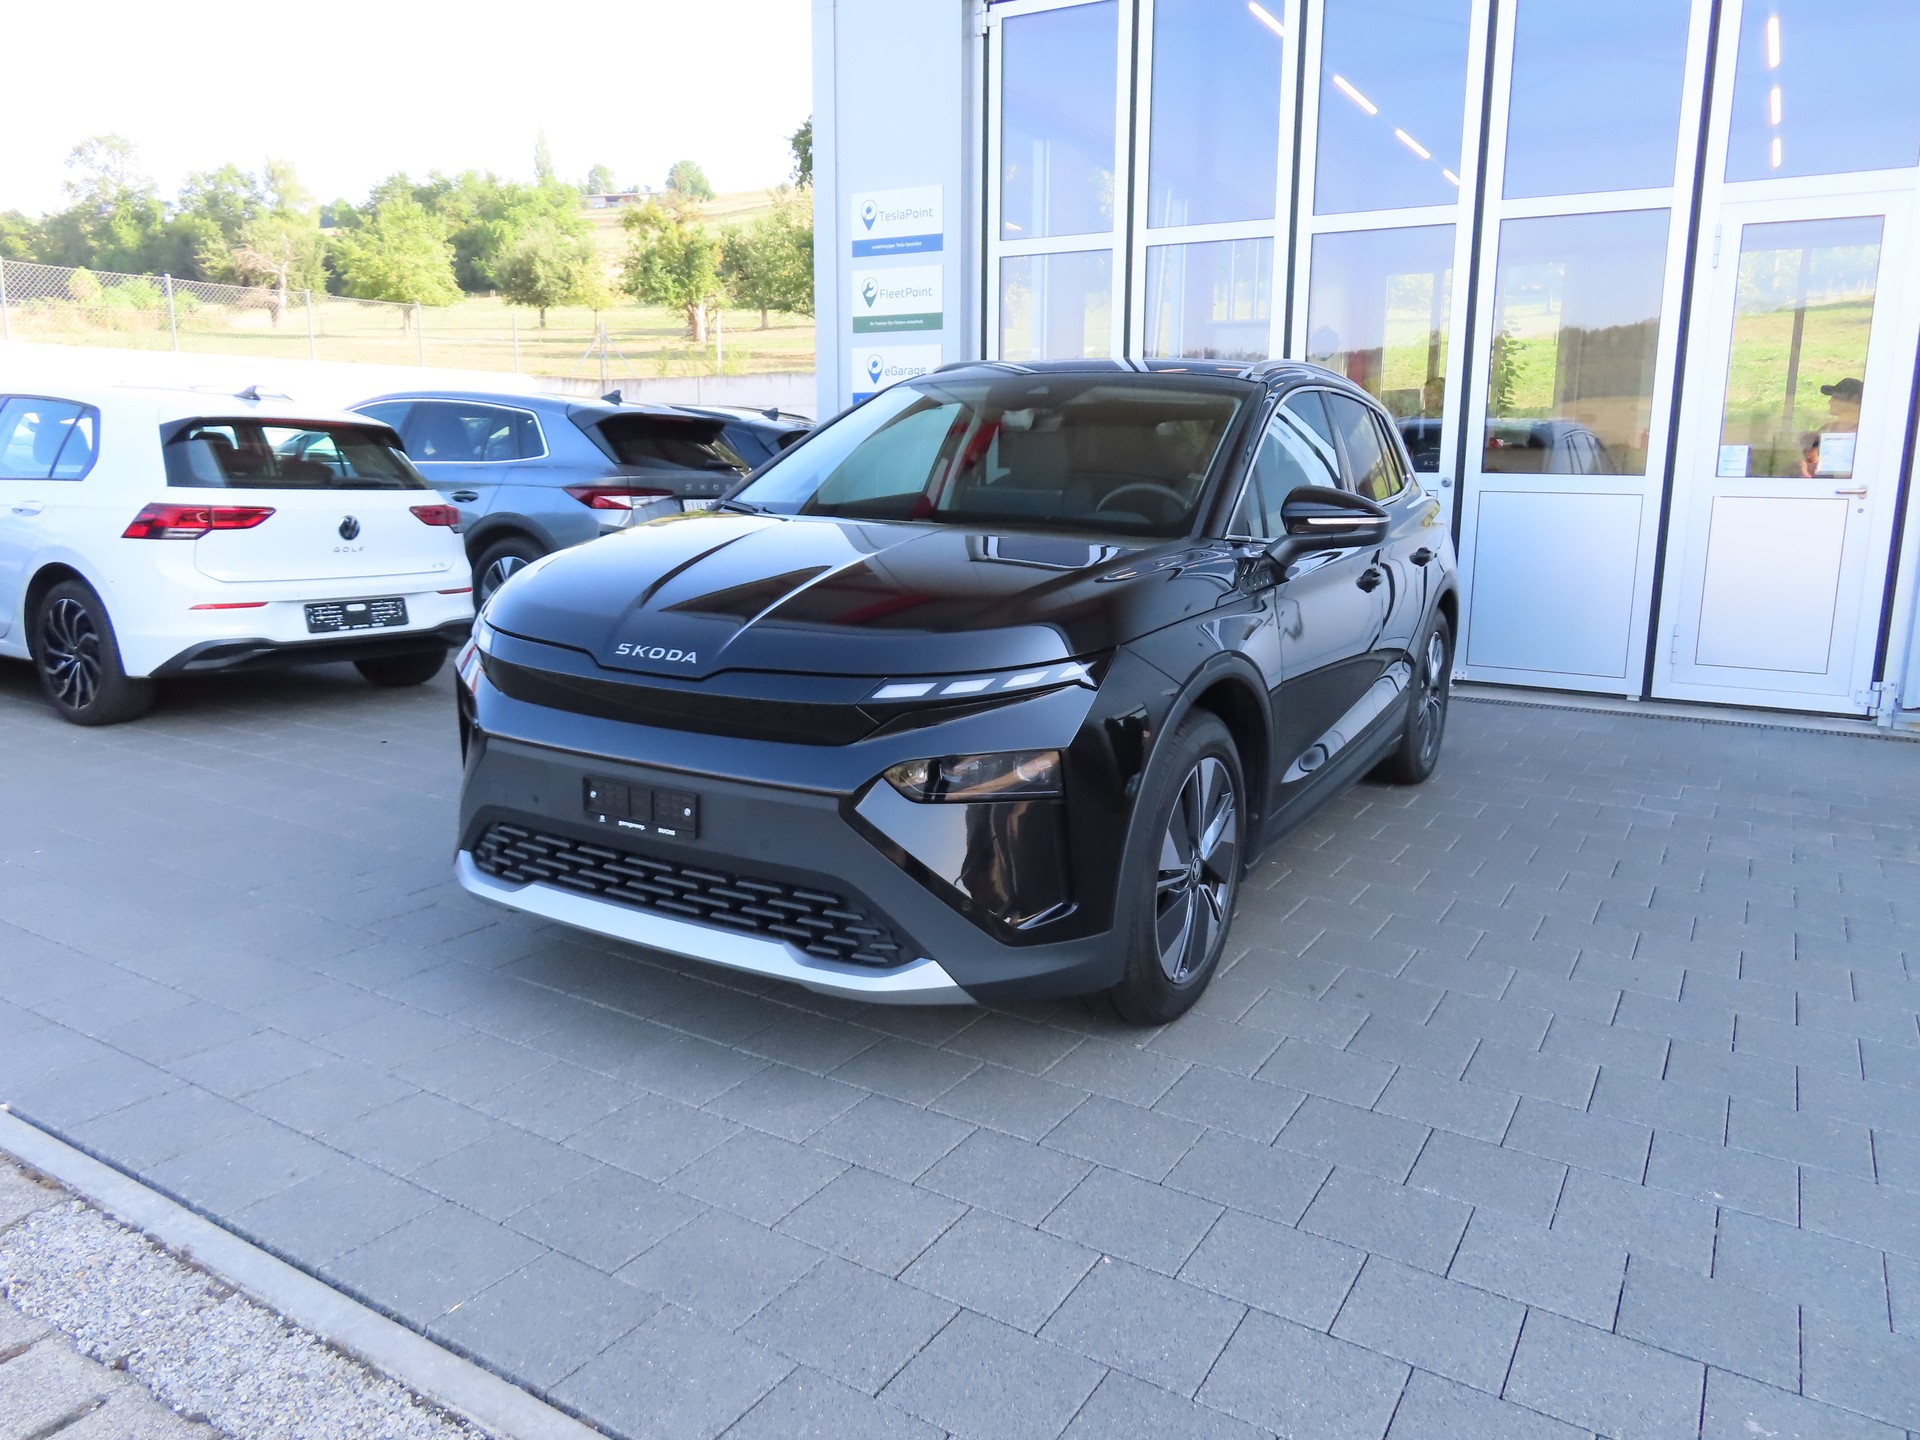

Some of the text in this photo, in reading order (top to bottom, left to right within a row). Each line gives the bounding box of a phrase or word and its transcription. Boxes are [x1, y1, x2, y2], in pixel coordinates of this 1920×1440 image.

[879, 207, 933, 222] TeslaPoint
[879, 287, 933, 299] FleetPoint
[884, 365, 927, 376] eGarage
[685, 483, 731, 491] SKOD
[615, 643, 697, 664] SKODA
